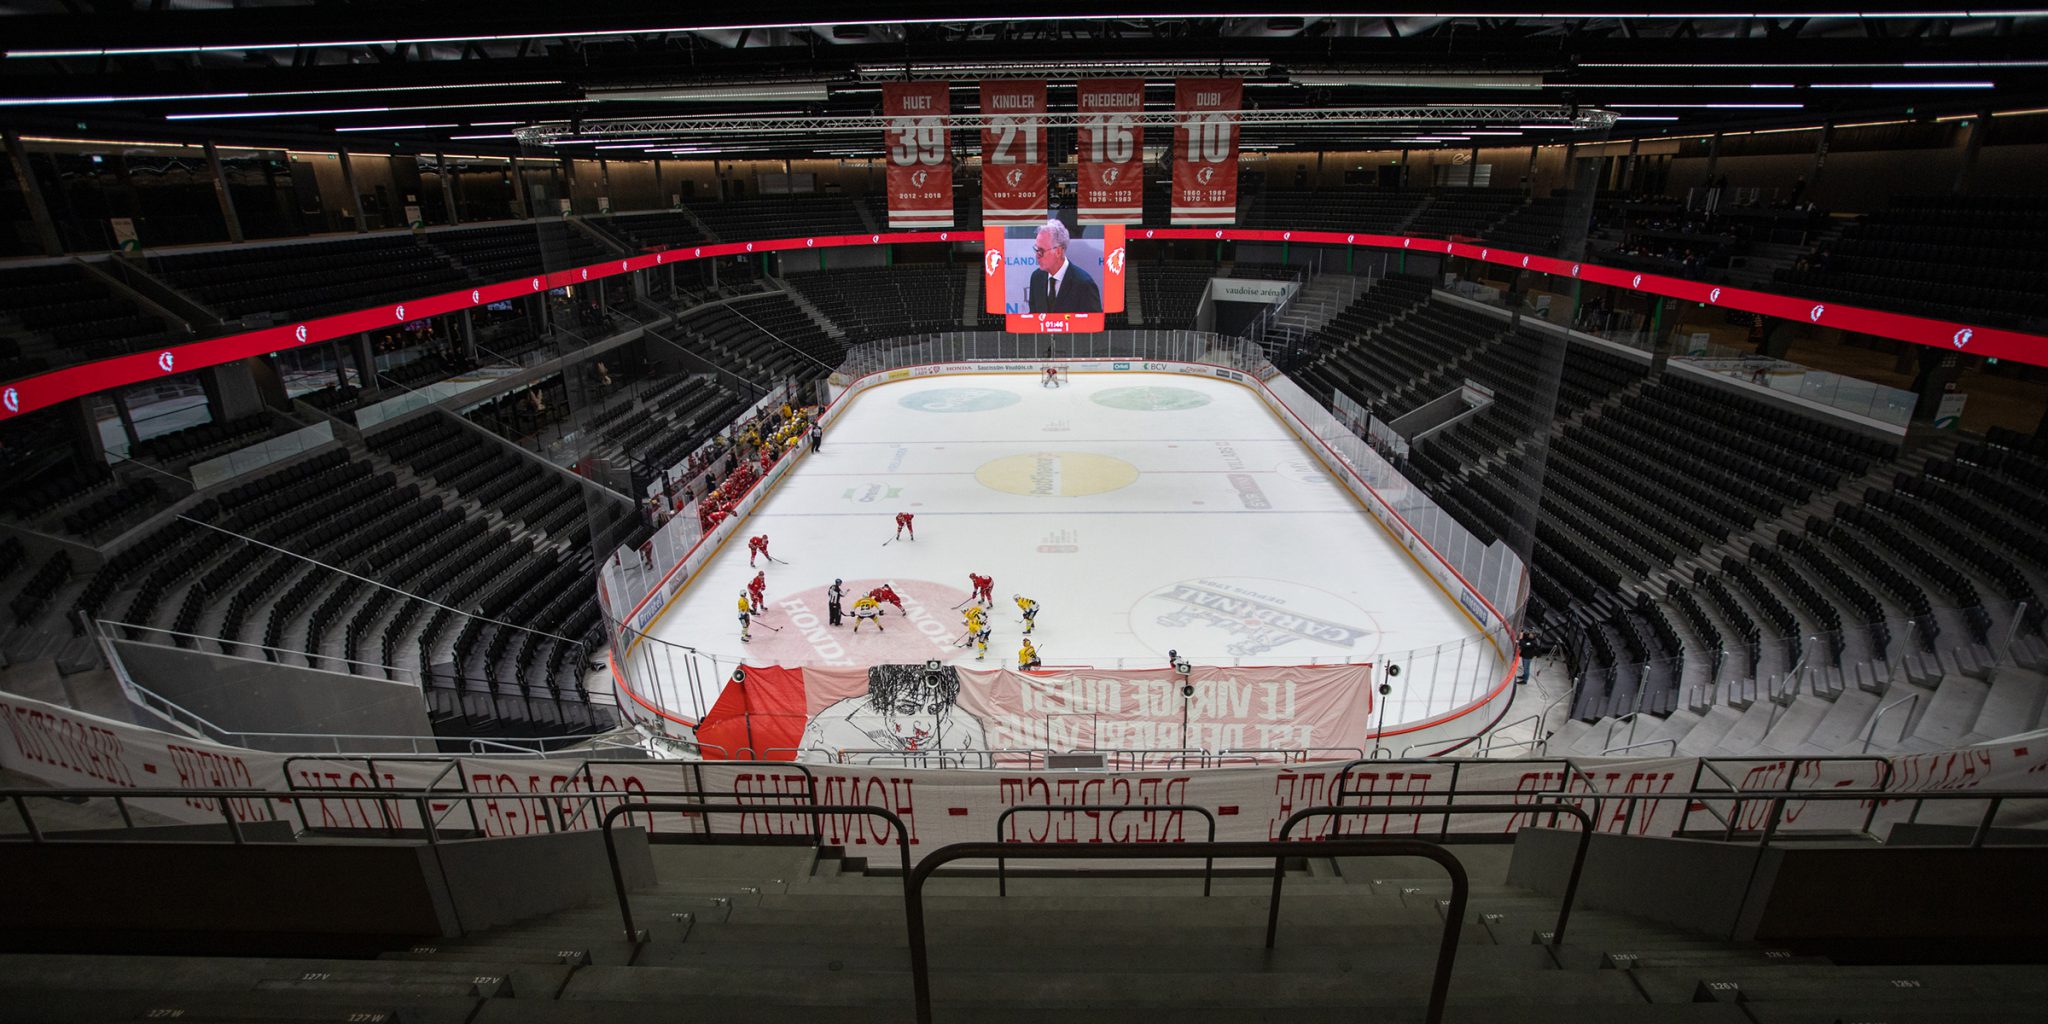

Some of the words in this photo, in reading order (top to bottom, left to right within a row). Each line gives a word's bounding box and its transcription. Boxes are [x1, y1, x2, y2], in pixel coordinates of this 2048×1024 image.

[903, 95, 933, 110] HUET
[992, 94, 1035, 108] KINDLER
[1082, 92, 1141, 107] FRIEDERICH
[1196, 92, 1221, 106] DUBI
[891, 116, 945, 166] 39
[990, 115, 1038, 165] 21
[1084, 113, 1134, 164] 16
[1181, 112, 1231, 163] 10
[1225, 286, 1259, 295] vaudoise
[1150, 363, 1167, 371] BCV
[1177, 585, 1351, 641] CARDINAL
[348, 1013, 371, 1023] 127
